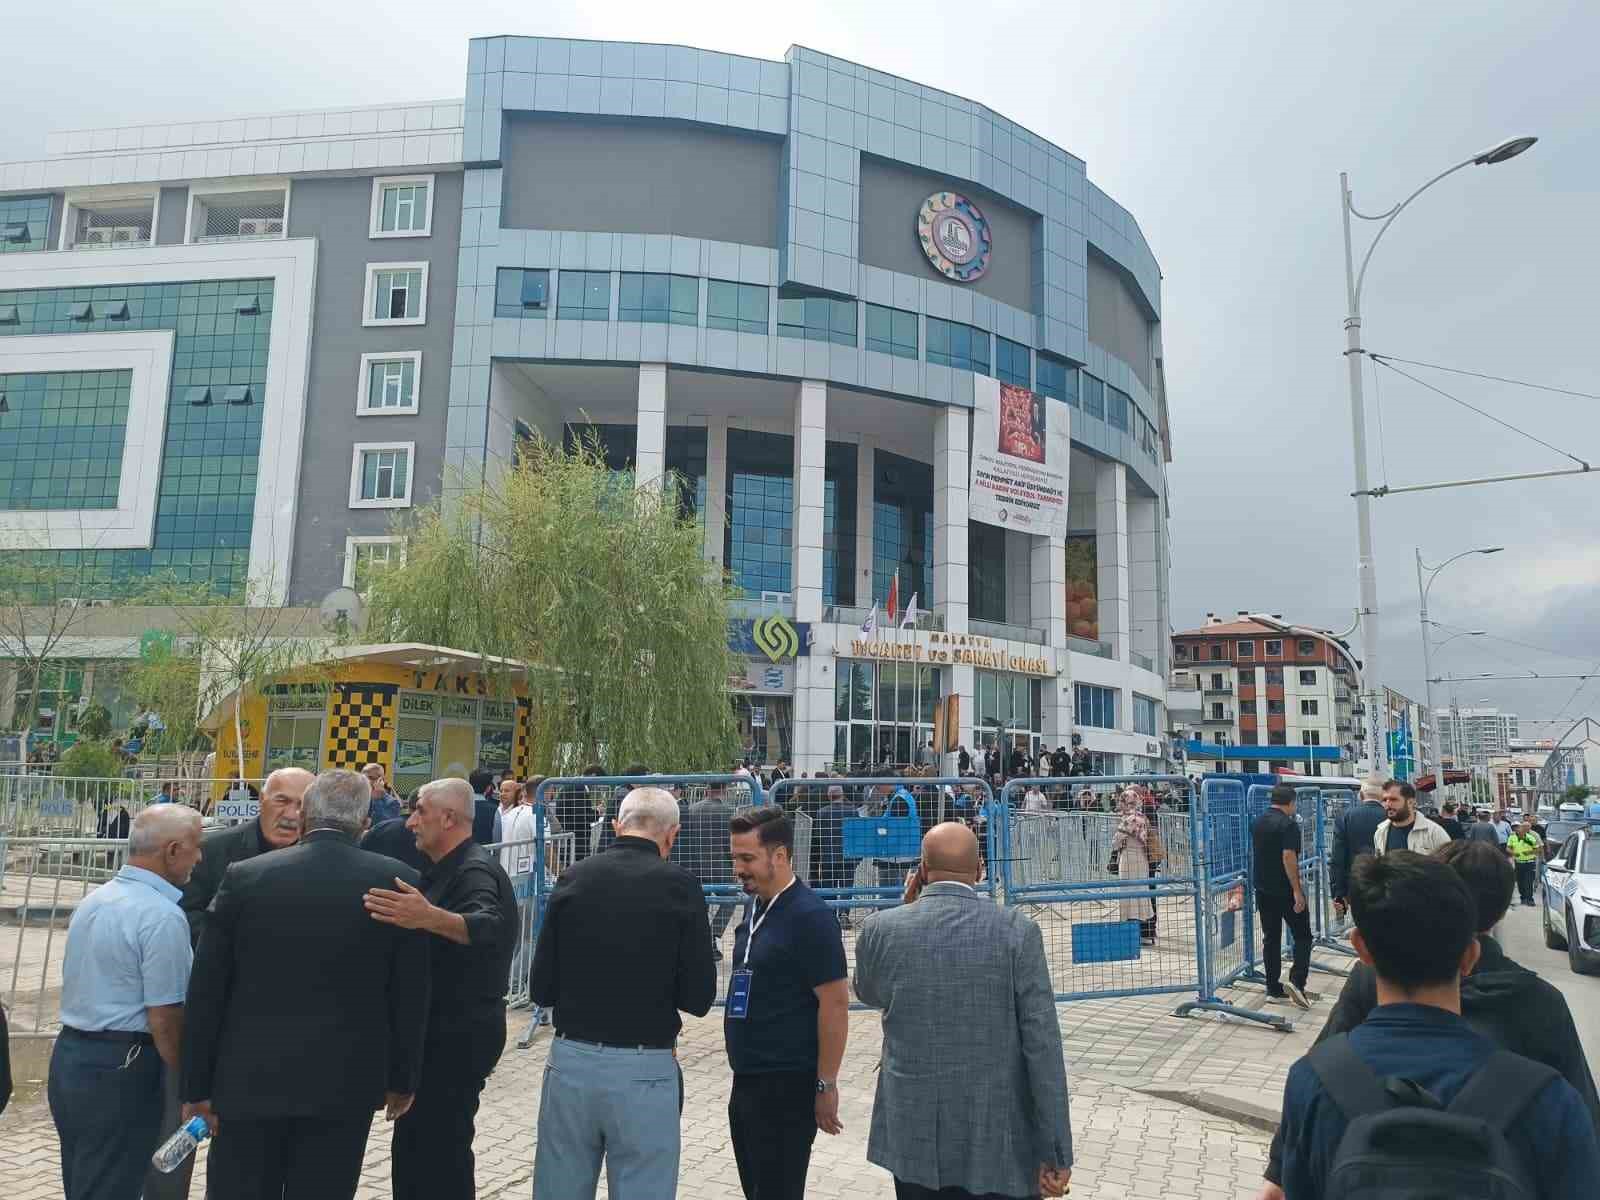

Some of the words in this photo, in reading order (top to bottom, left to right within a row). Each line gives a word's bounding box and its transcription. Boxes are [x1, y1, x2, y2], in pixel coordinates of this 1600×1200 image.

[930, 632, 990, 648] MALATYA
[953, 647, 1007, 668] SANAYİ
[1009, 656, 1049, 674] ODASI
